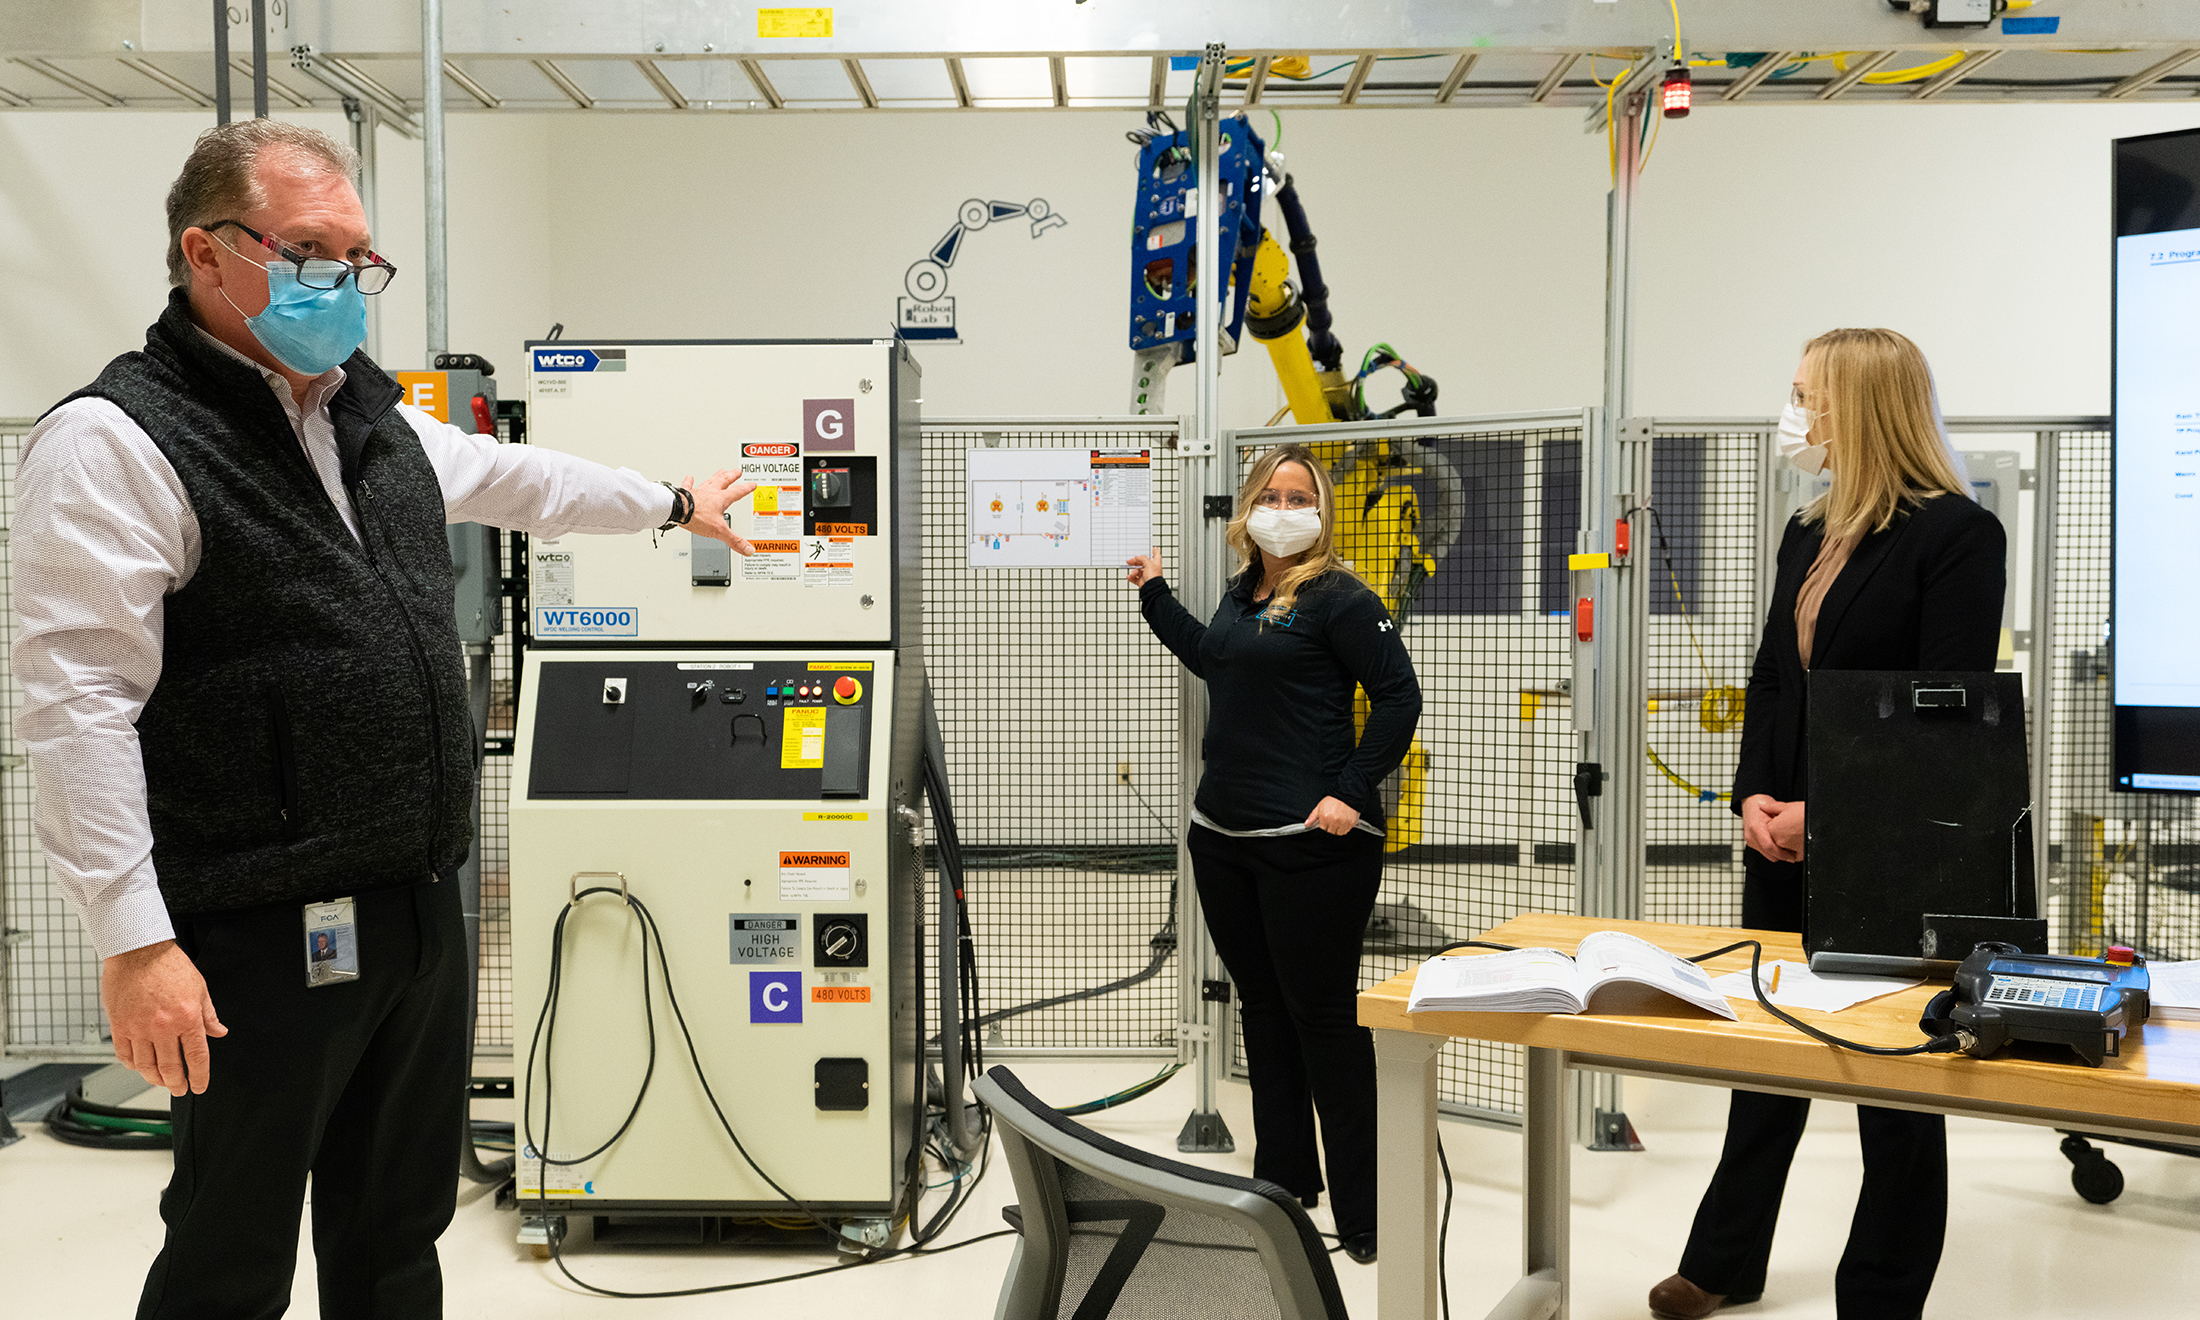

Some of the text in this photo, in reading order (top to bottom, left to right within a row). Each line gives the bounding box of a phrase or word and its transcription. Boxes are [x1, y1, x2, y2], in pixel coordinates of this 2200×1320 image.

[913, 303, 951, 312] Robot
[913, 314, 938, 323] Lab
[412, 382, 436, 411] E
[815, 409, 844, 440] G
[750, 445, 791, 455] DANGER
[741, 463, 761, 473] HIGH
[762, 463, 800, 473] VOLTAGE
[816, 525, 866, 534] 480 VOLTS
[753, 542, 798, 551] WARNING
[536, 553, 571, 562] wtco
[543, 611, 631, 626] WT6000
[792, 855, 847, 865] WARNING
[748, 921, 783, 929] DANGER
[751, 934, 780, 945] HIGH
[737, 947, 794, 958] VOLTAGE
[762, 981, 789, 1013] C
[816, 989, 866, 1000] 480 VOLTS
